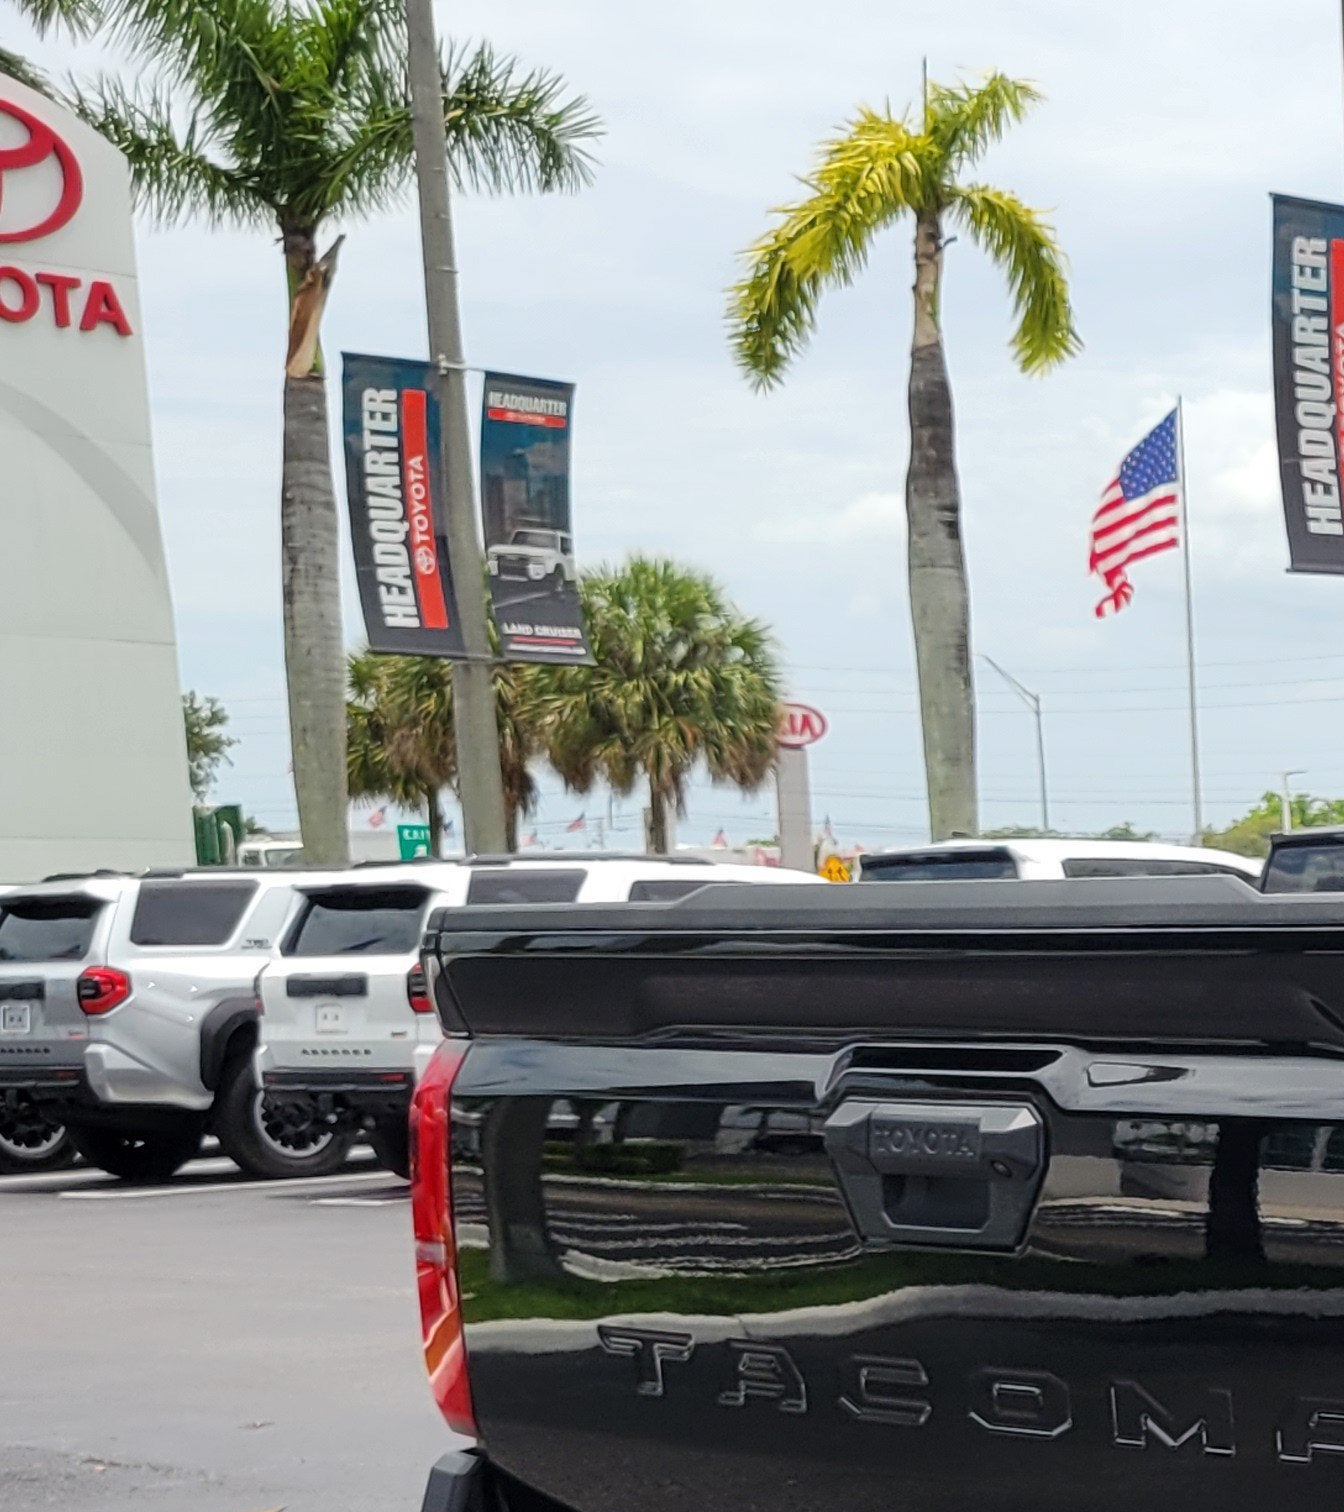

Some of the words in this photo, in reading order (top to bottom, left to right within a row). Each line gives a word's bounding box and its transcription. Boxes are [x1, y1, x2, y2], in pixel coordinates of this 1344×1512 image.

[1291, 236, 1344, 535] HEADQUARTER
[362, 388, 421, 629] HEADQUARTER
[408, 455, 431, 544] TOYOTA
[502, 622, 534, 636] LAND
[874, 1128, 975, 1157] TOYOTA
